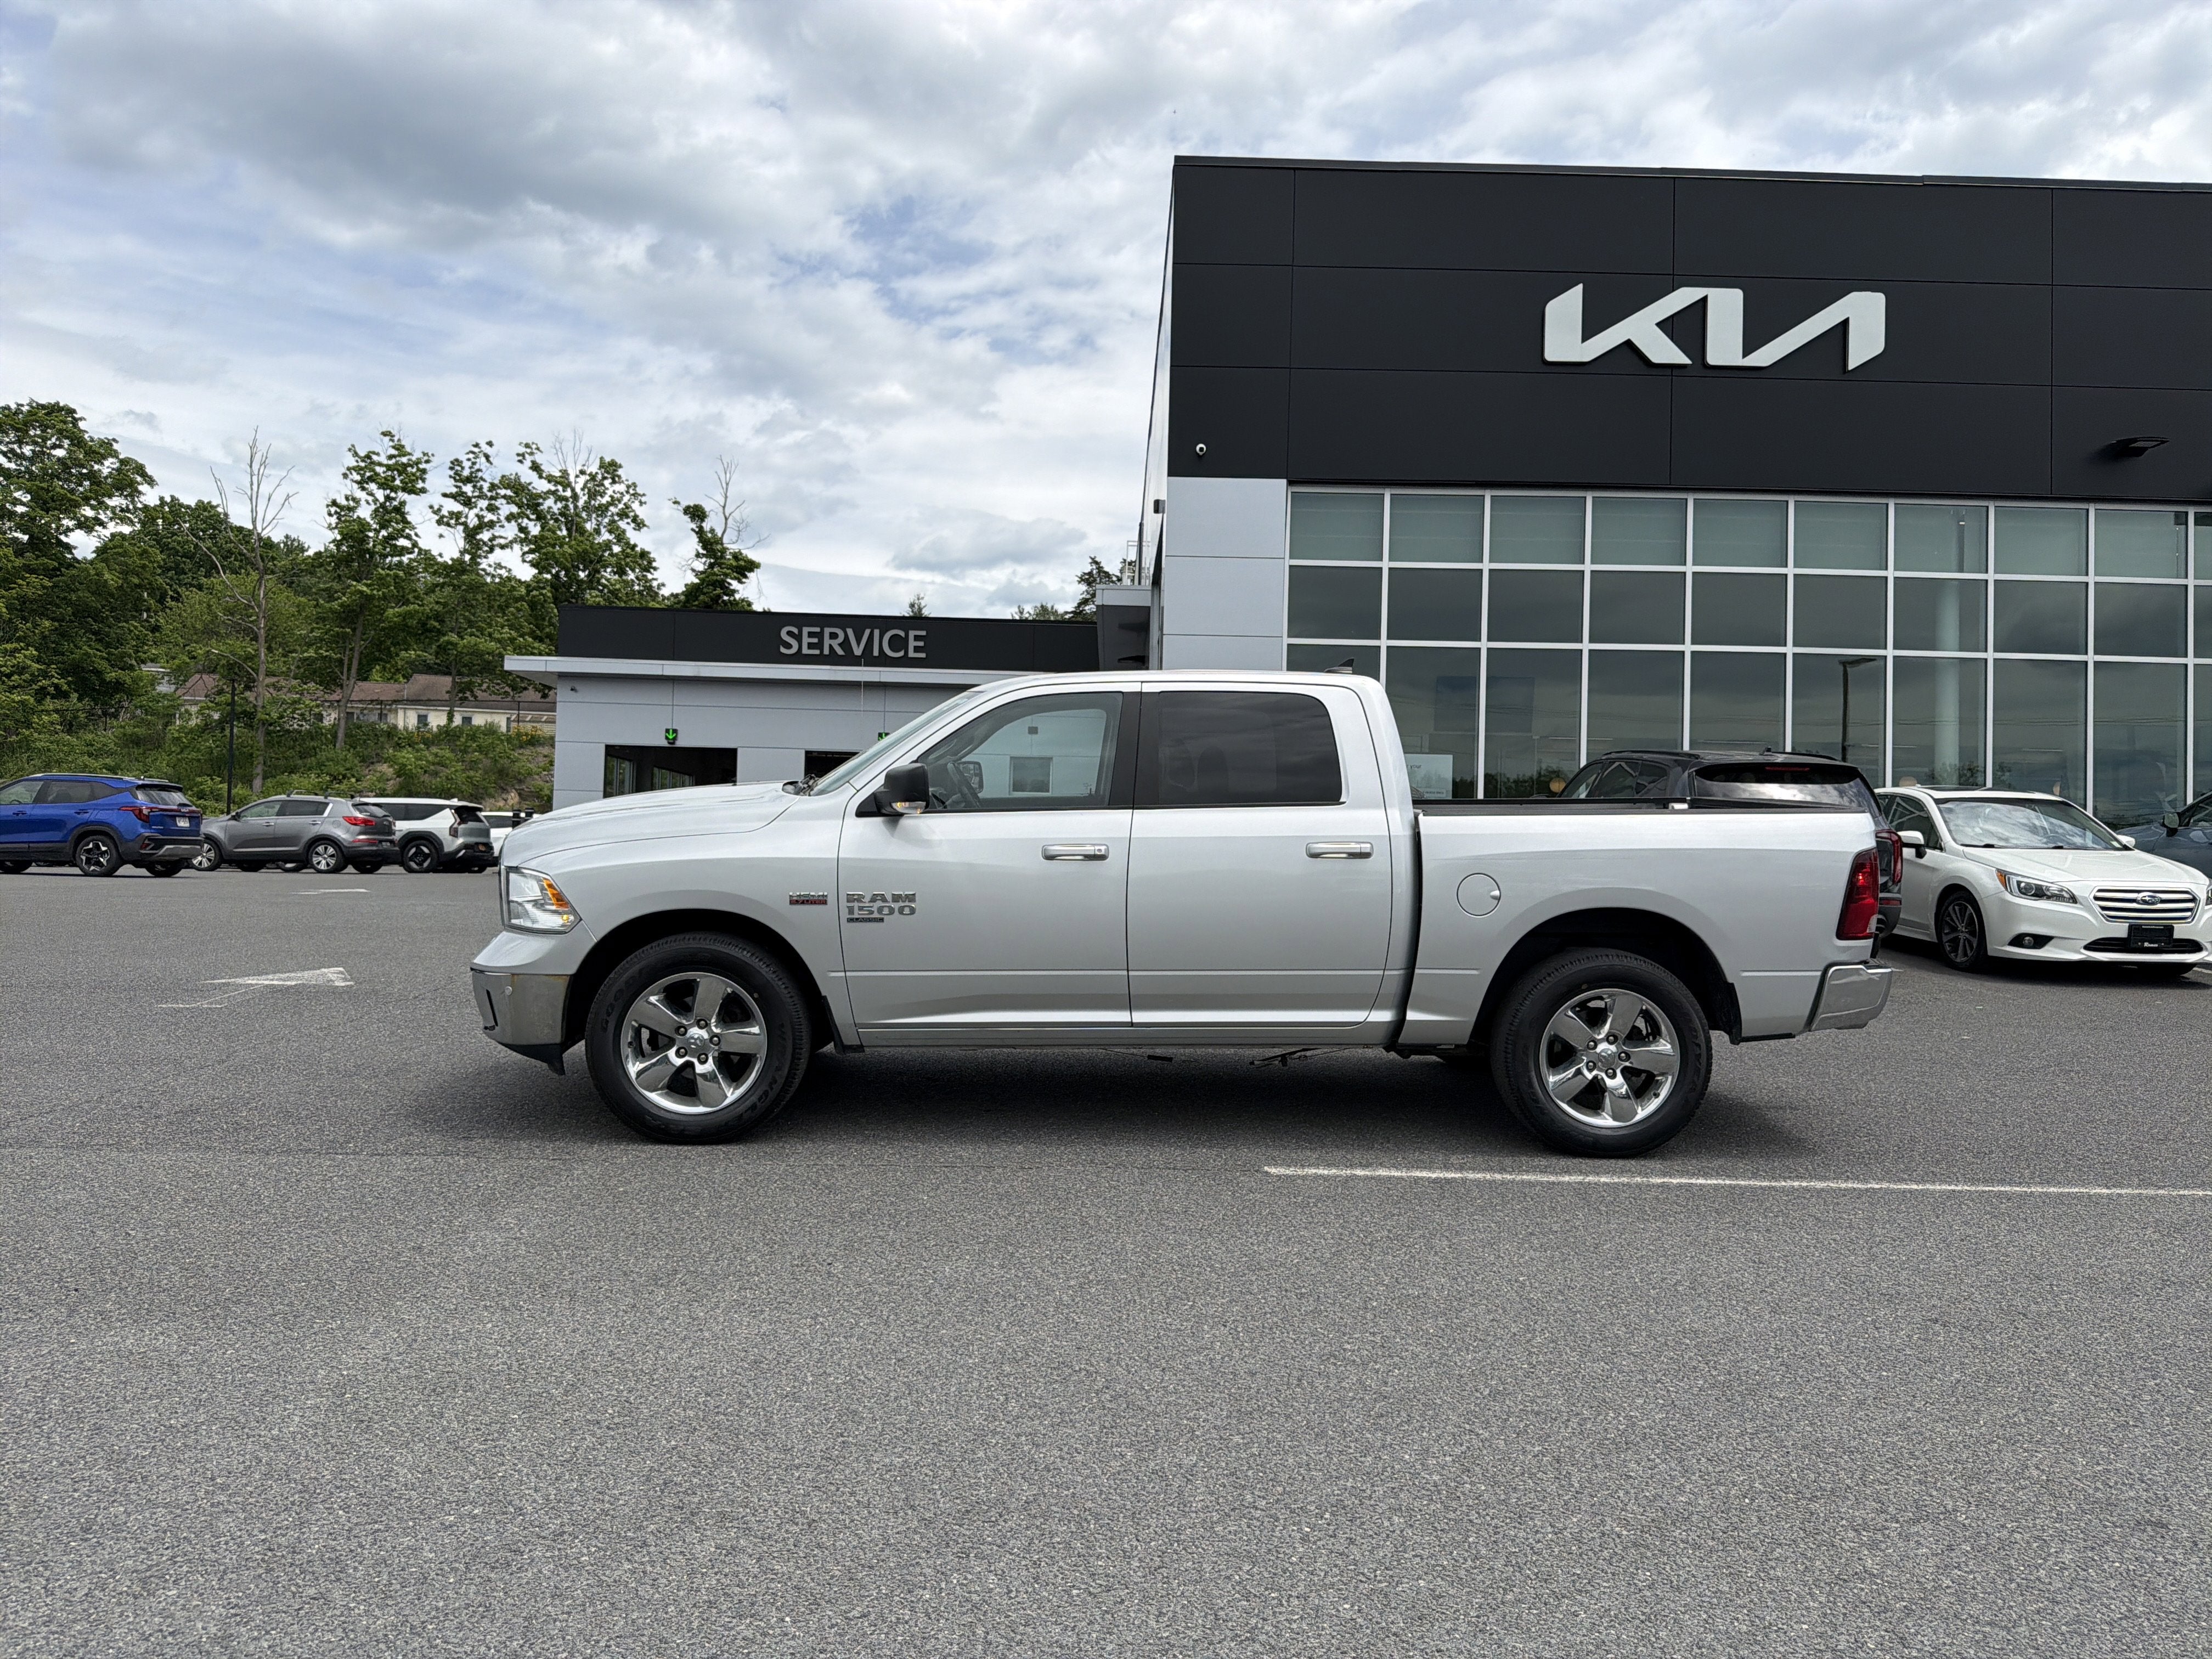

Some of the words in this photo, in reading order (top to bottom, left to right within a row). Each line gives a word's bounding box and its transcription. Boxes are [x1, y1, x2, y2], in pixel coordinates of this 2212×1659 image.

[1543, 283, 1886, 371] KIA
[780, 625, 927, 658] SERVICE
[846, 891, 916, 903] RAM
[846, 904, 916, 916] 1500
